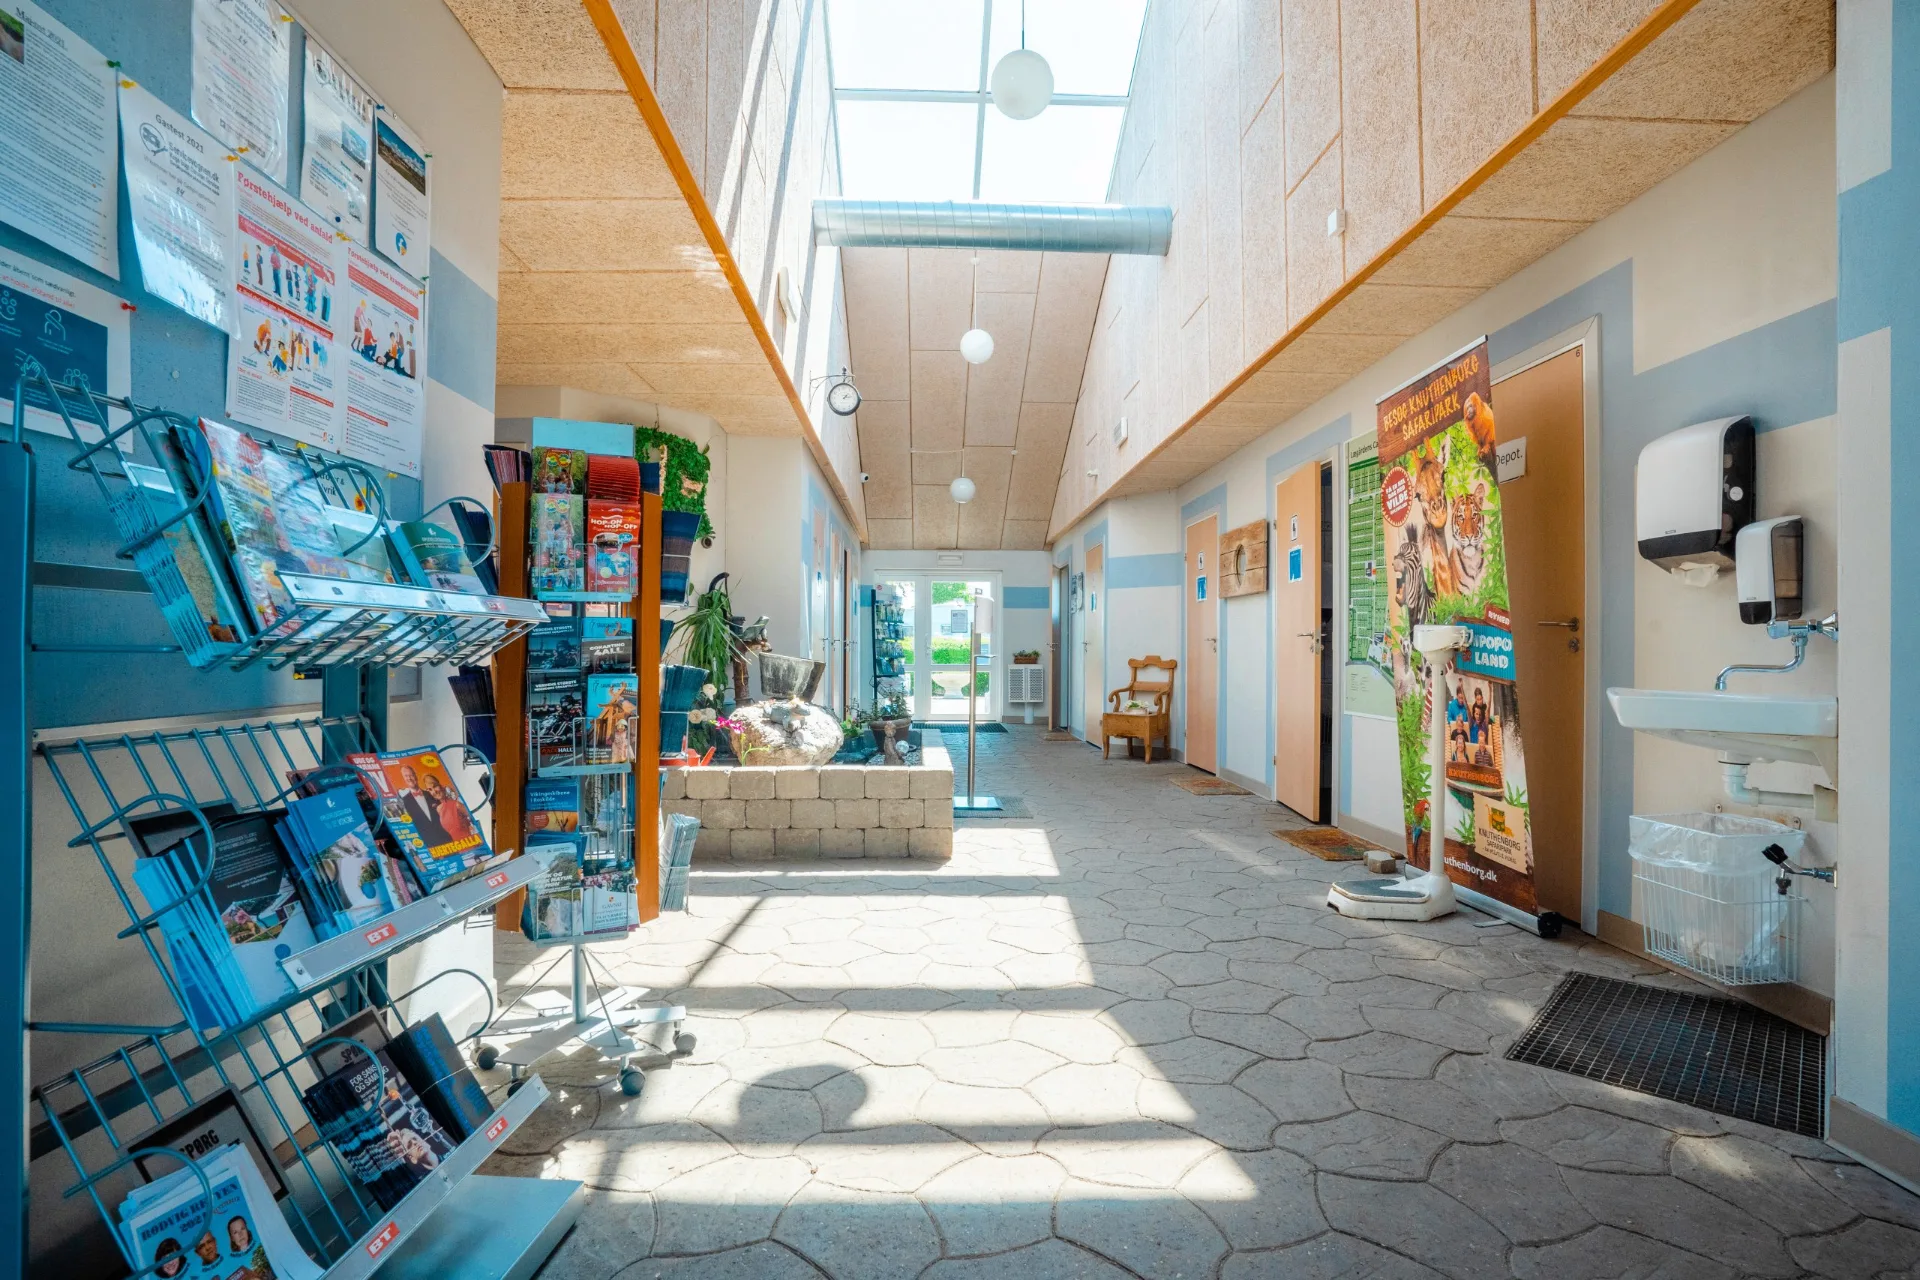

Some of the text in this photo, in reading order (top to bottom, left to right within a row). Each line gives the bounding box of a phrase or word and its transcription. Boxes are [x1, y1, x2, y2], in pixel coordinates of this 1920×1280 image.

[155, 114, 204, 154] Gastest 2021
[237, 171, 292, 217] Førstehjælp
[294, 211, 309, 227] ved
[310, 223, 333, 244] anfald
[1383, 353, 1480, 432] BESØG KNUTHENBORG
[1402, 391, 1461, 441] SAFARIPARK
[1386, 490, 1408, 511] VILDE
[589, 643, 625, 651] GOKARTING
[1474, 651, 1509, 669] LAND
[1447, 768, 1499, 785] KNUTHENBORG
[1478, 827, 1521, 851] KNUTHENBORG
[487, 873, 506, 888] BT
[1444, 855, 1498, 883] uthenborg.dk
[366, 925, 395, 945] BT
[349, 1064, 378, 1088] FOR SANS
[354, 1082, 366, 1093] OG
[487, 1119, 506, 1138] BT
[190, 1183, 239, 1214] REYEN
[367, 1225, 396, 1256] BT
